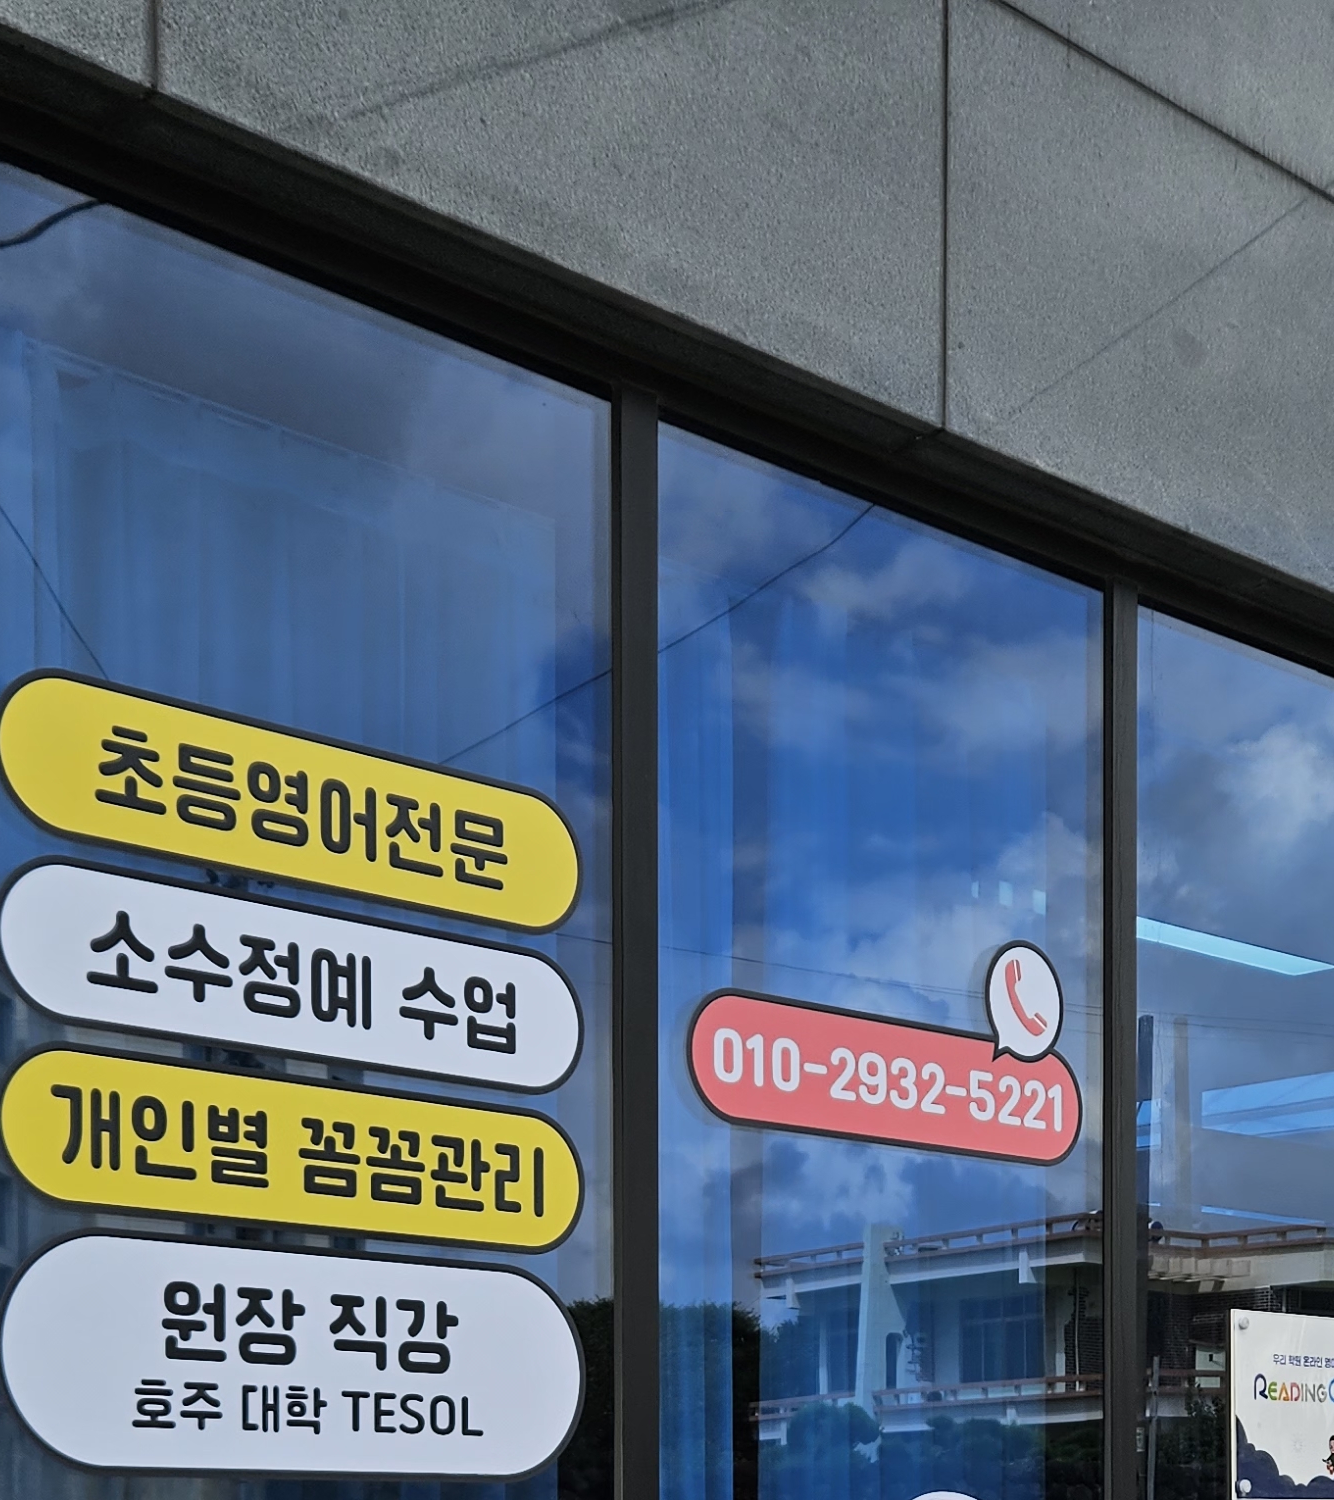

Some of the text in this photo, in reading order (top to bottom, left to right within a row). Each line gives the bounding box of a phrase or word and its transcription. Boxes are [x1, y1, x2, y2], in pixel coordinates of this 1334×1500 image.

[94, 725, 508, 891] 초등영어전문
[87, 910, 517, 1054] 소수정예 수업
[713, 1027, 1063, 1133] 010-2932-5221
[50, 1083, 546, 1217] 개인별 꼼꼼관리
[161, 1280, 459, 1374] 원장 직강
[1273, 1354, 1286, 1365] 우리
[1303, 1356, 1322, 1368] 온라인
[131, 1378, 484, 1438] 호주 대학 TESOL
